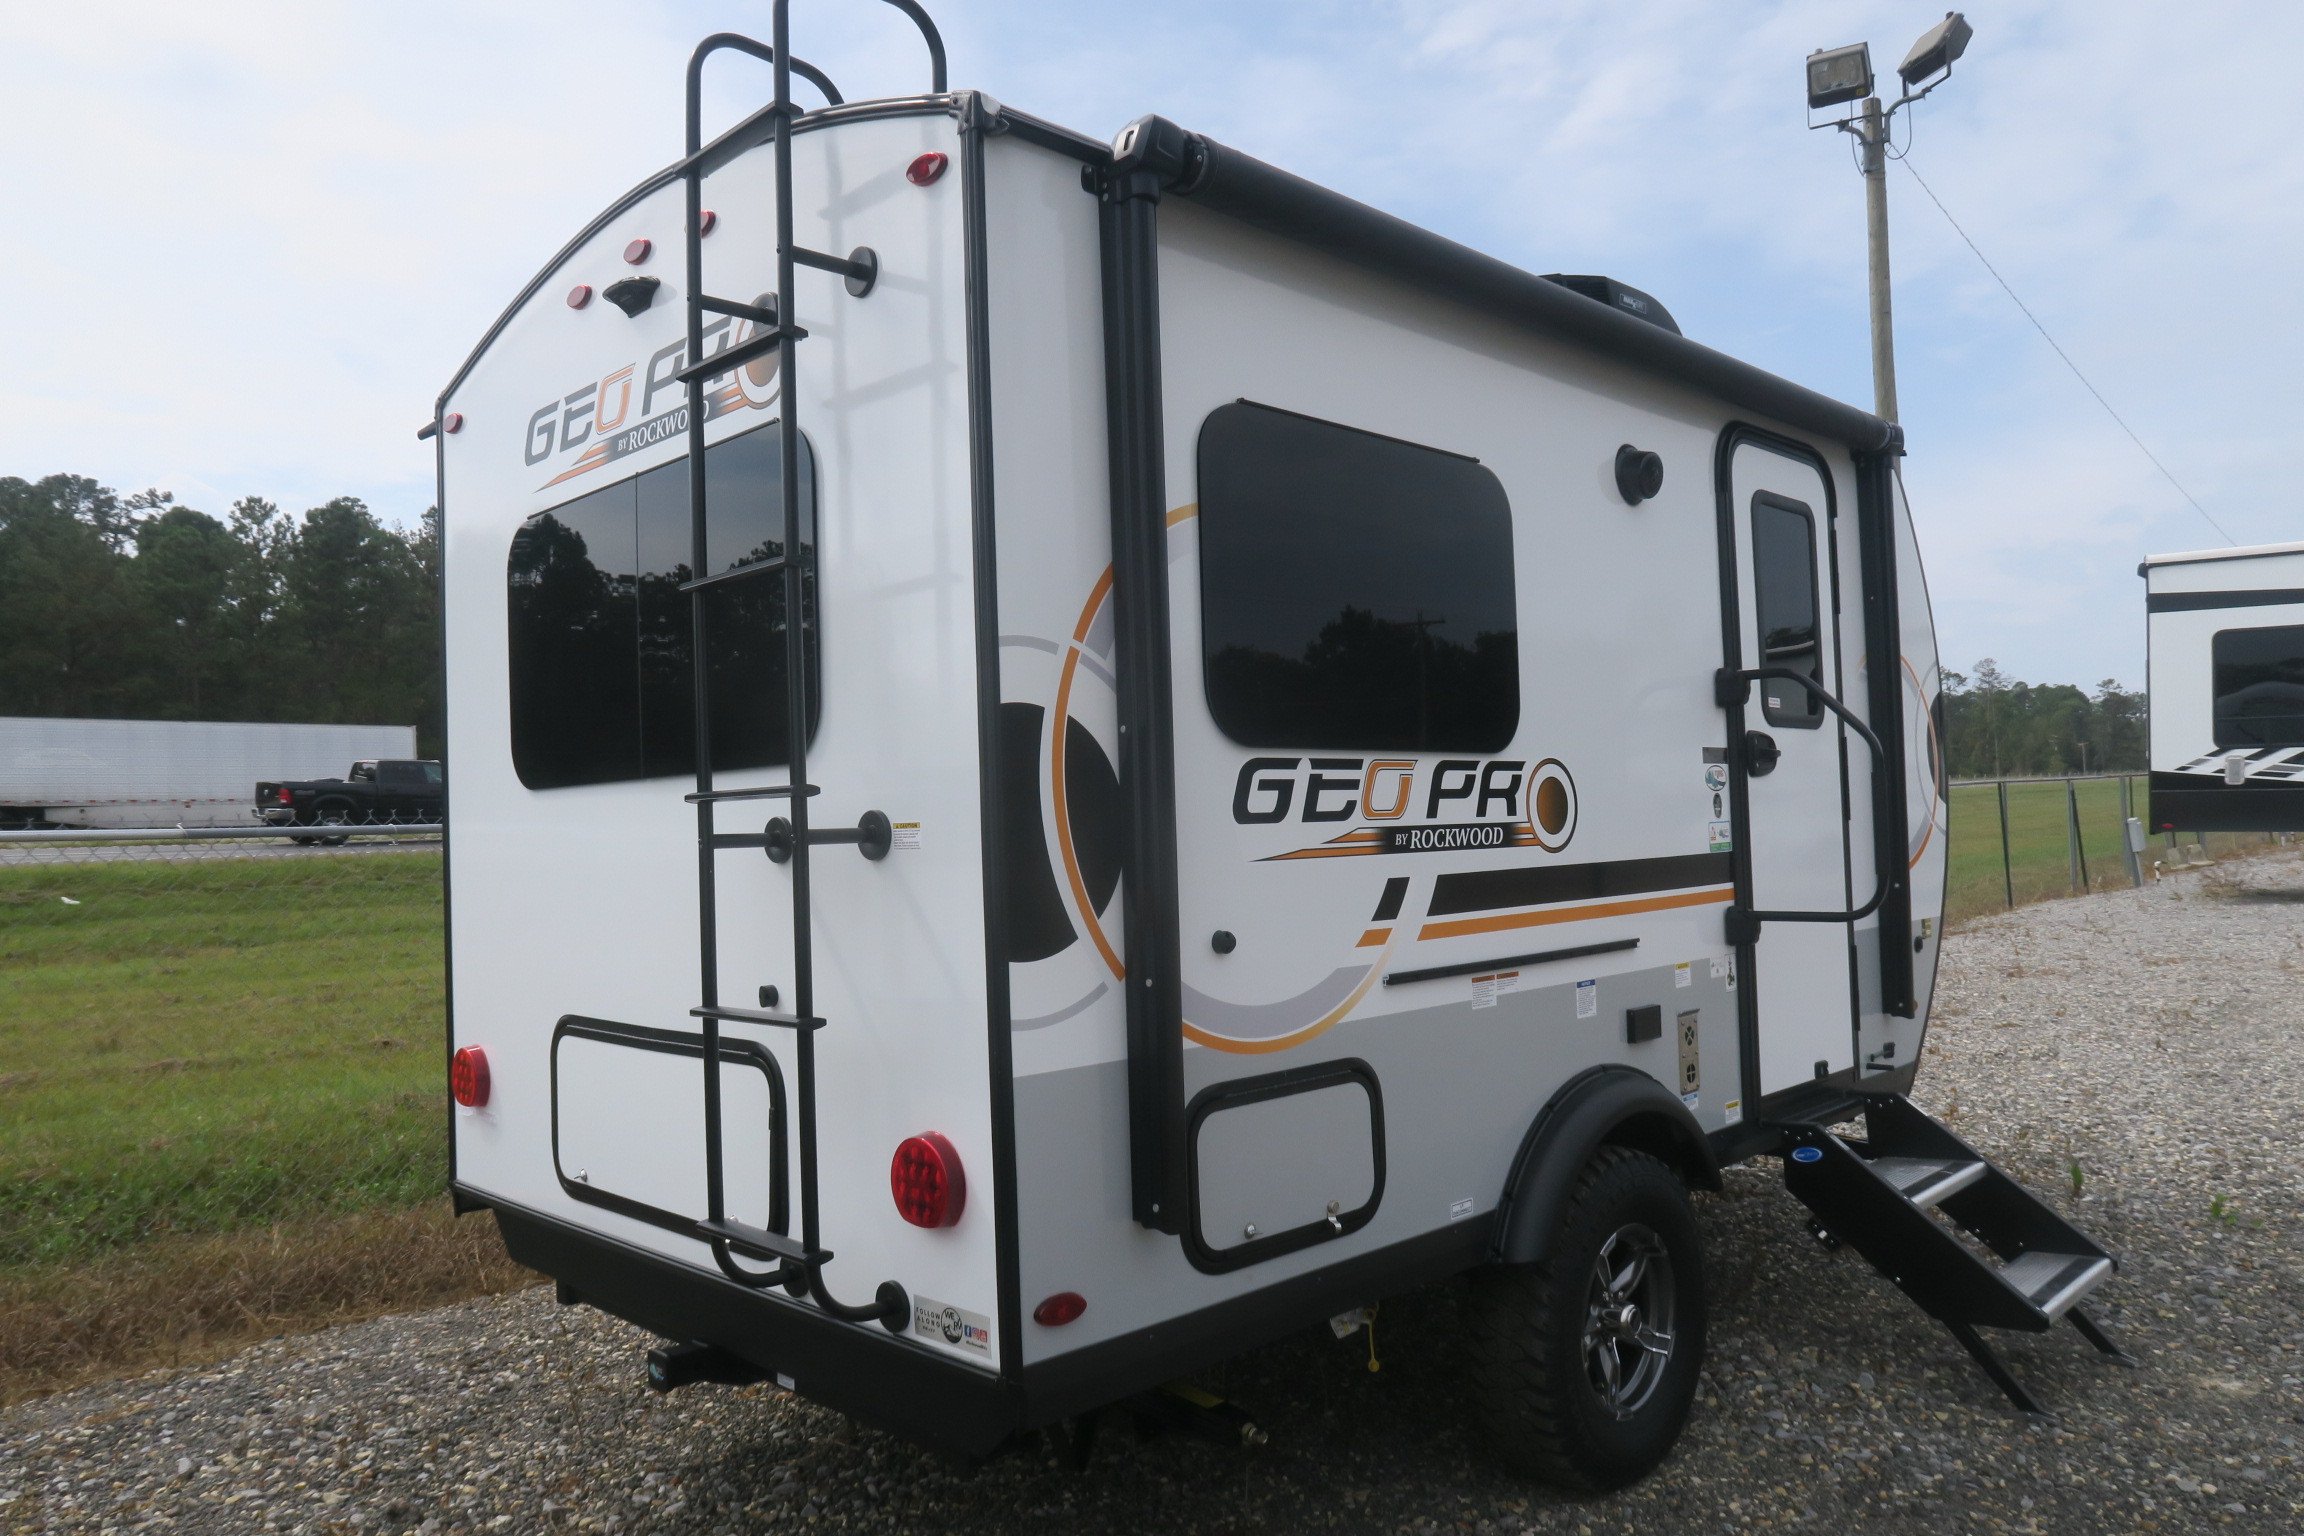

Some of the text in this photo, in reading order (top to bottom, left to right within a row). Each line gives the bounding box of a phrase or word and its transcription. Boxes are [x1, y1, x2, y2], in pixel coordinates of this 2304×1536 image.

[524, 362, 636, 467] GEO
[617, 400, 710, 451] BY ROCKWOD
[1232, 757, 1578, 853] GEO PRO
[1395, 826, 1504, 849] BY ROCKWOOD
[916, 1306, 941, 1320] FOLLOW
[917, 1315, 941, 1328] ALONG
[945, 1310, 955, 1320] WE
